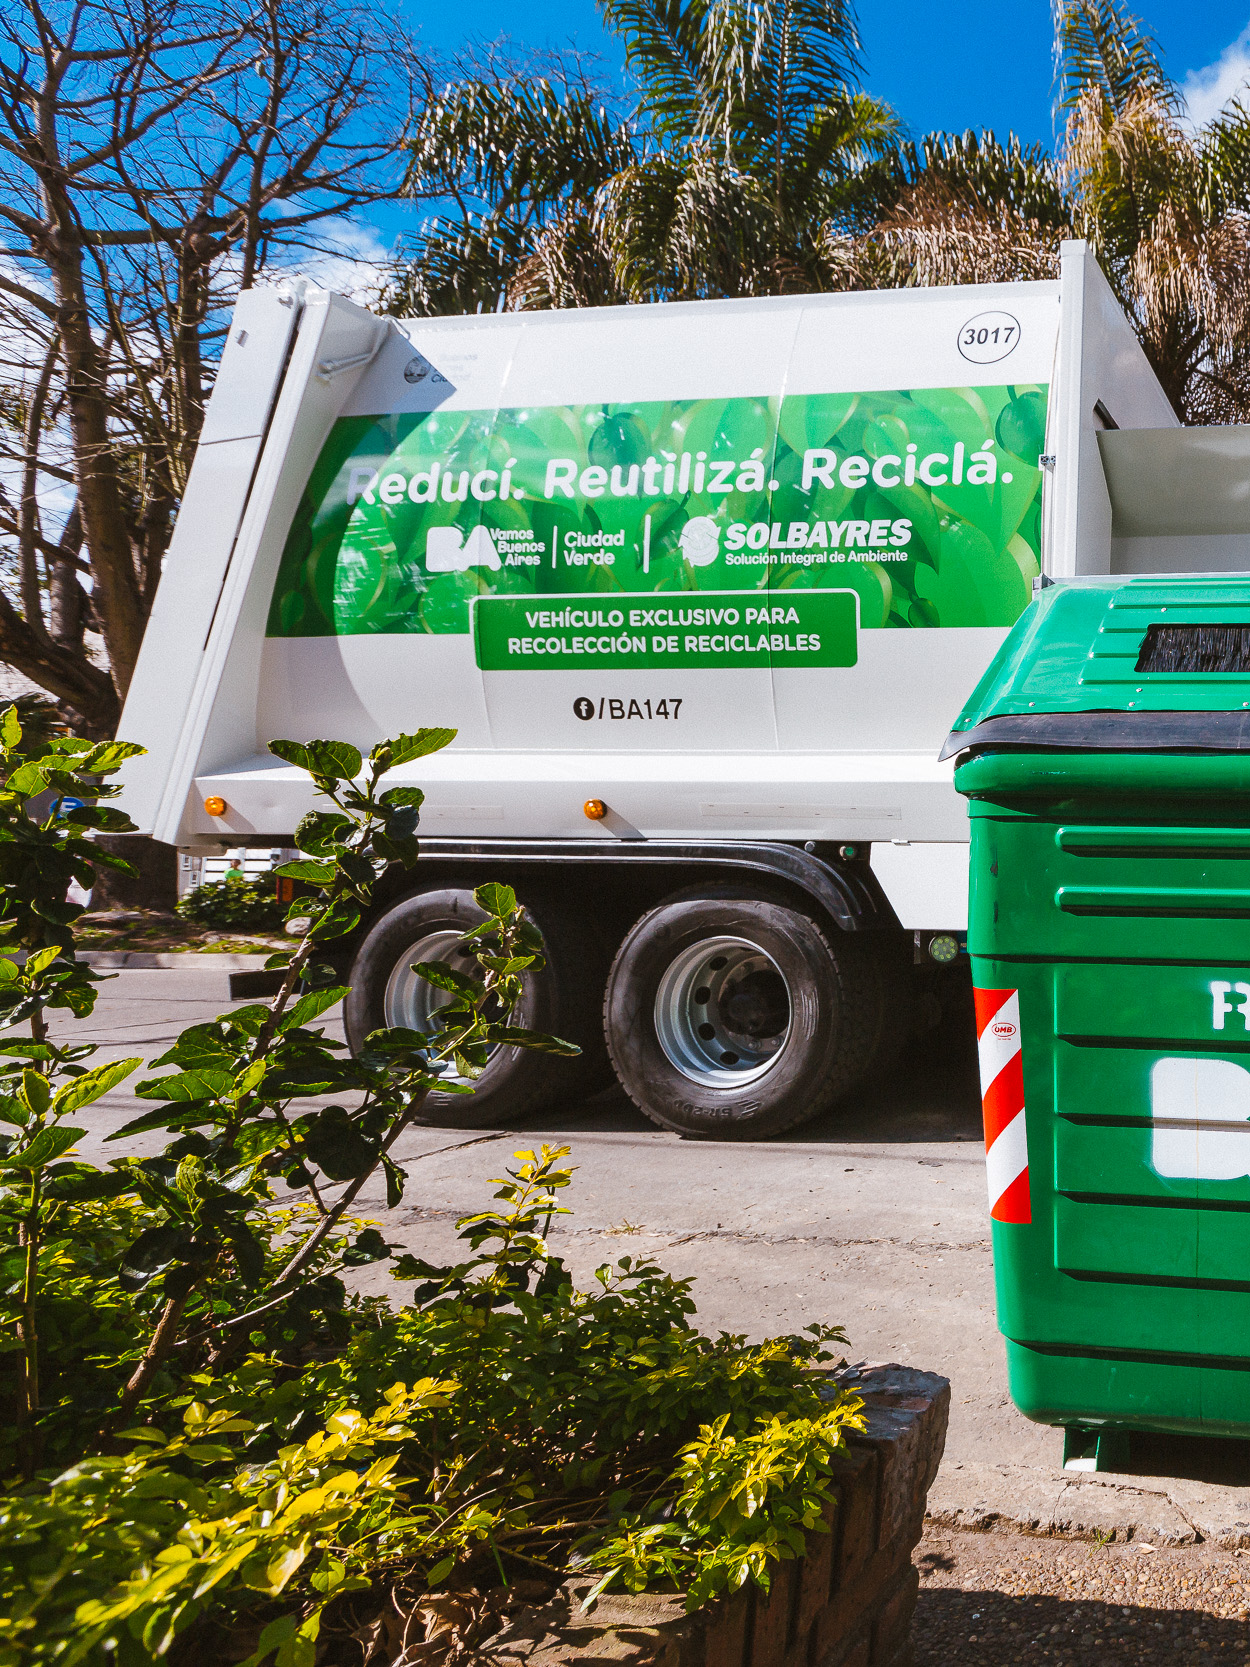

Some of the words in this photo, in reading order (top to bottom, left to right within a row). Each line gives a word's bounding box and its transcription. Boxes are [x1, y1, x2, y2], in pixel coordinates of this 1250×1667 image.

[963, 326, 1016, 345] 3017
[346, 457, 525, 505] Reducí.
[544, 447, 779, 499] Reutilizá.
[801, 439, 1013, 490] Reciclá.
[490, 528, 534, 541] Vamos
[564, 529, 625, 548] Ciudad
[723, 518, 913, 551] SOLBAYRES
[497, 540, 546, 553] Buenos
[504, 553, 541, 567] Aires
[564, 549, 616, 566] Verde
[725, 552, 778, 566] Solución
[780, 551, 827, 567] Integral
[830, 550, 846, 563] de
[848, 549, 908, 563] Ambiente
[525, 607, 624, 629] VEHÍCULO
[629, 607, 739, 627] EXCLUSIVO
[745, 607, 800, 625] PARA
[508, 632, 646, 654] RECOLECCIÓN
[653, 636, 678, 651] DE
[685, 633, 821, 652] RECICLABLES
